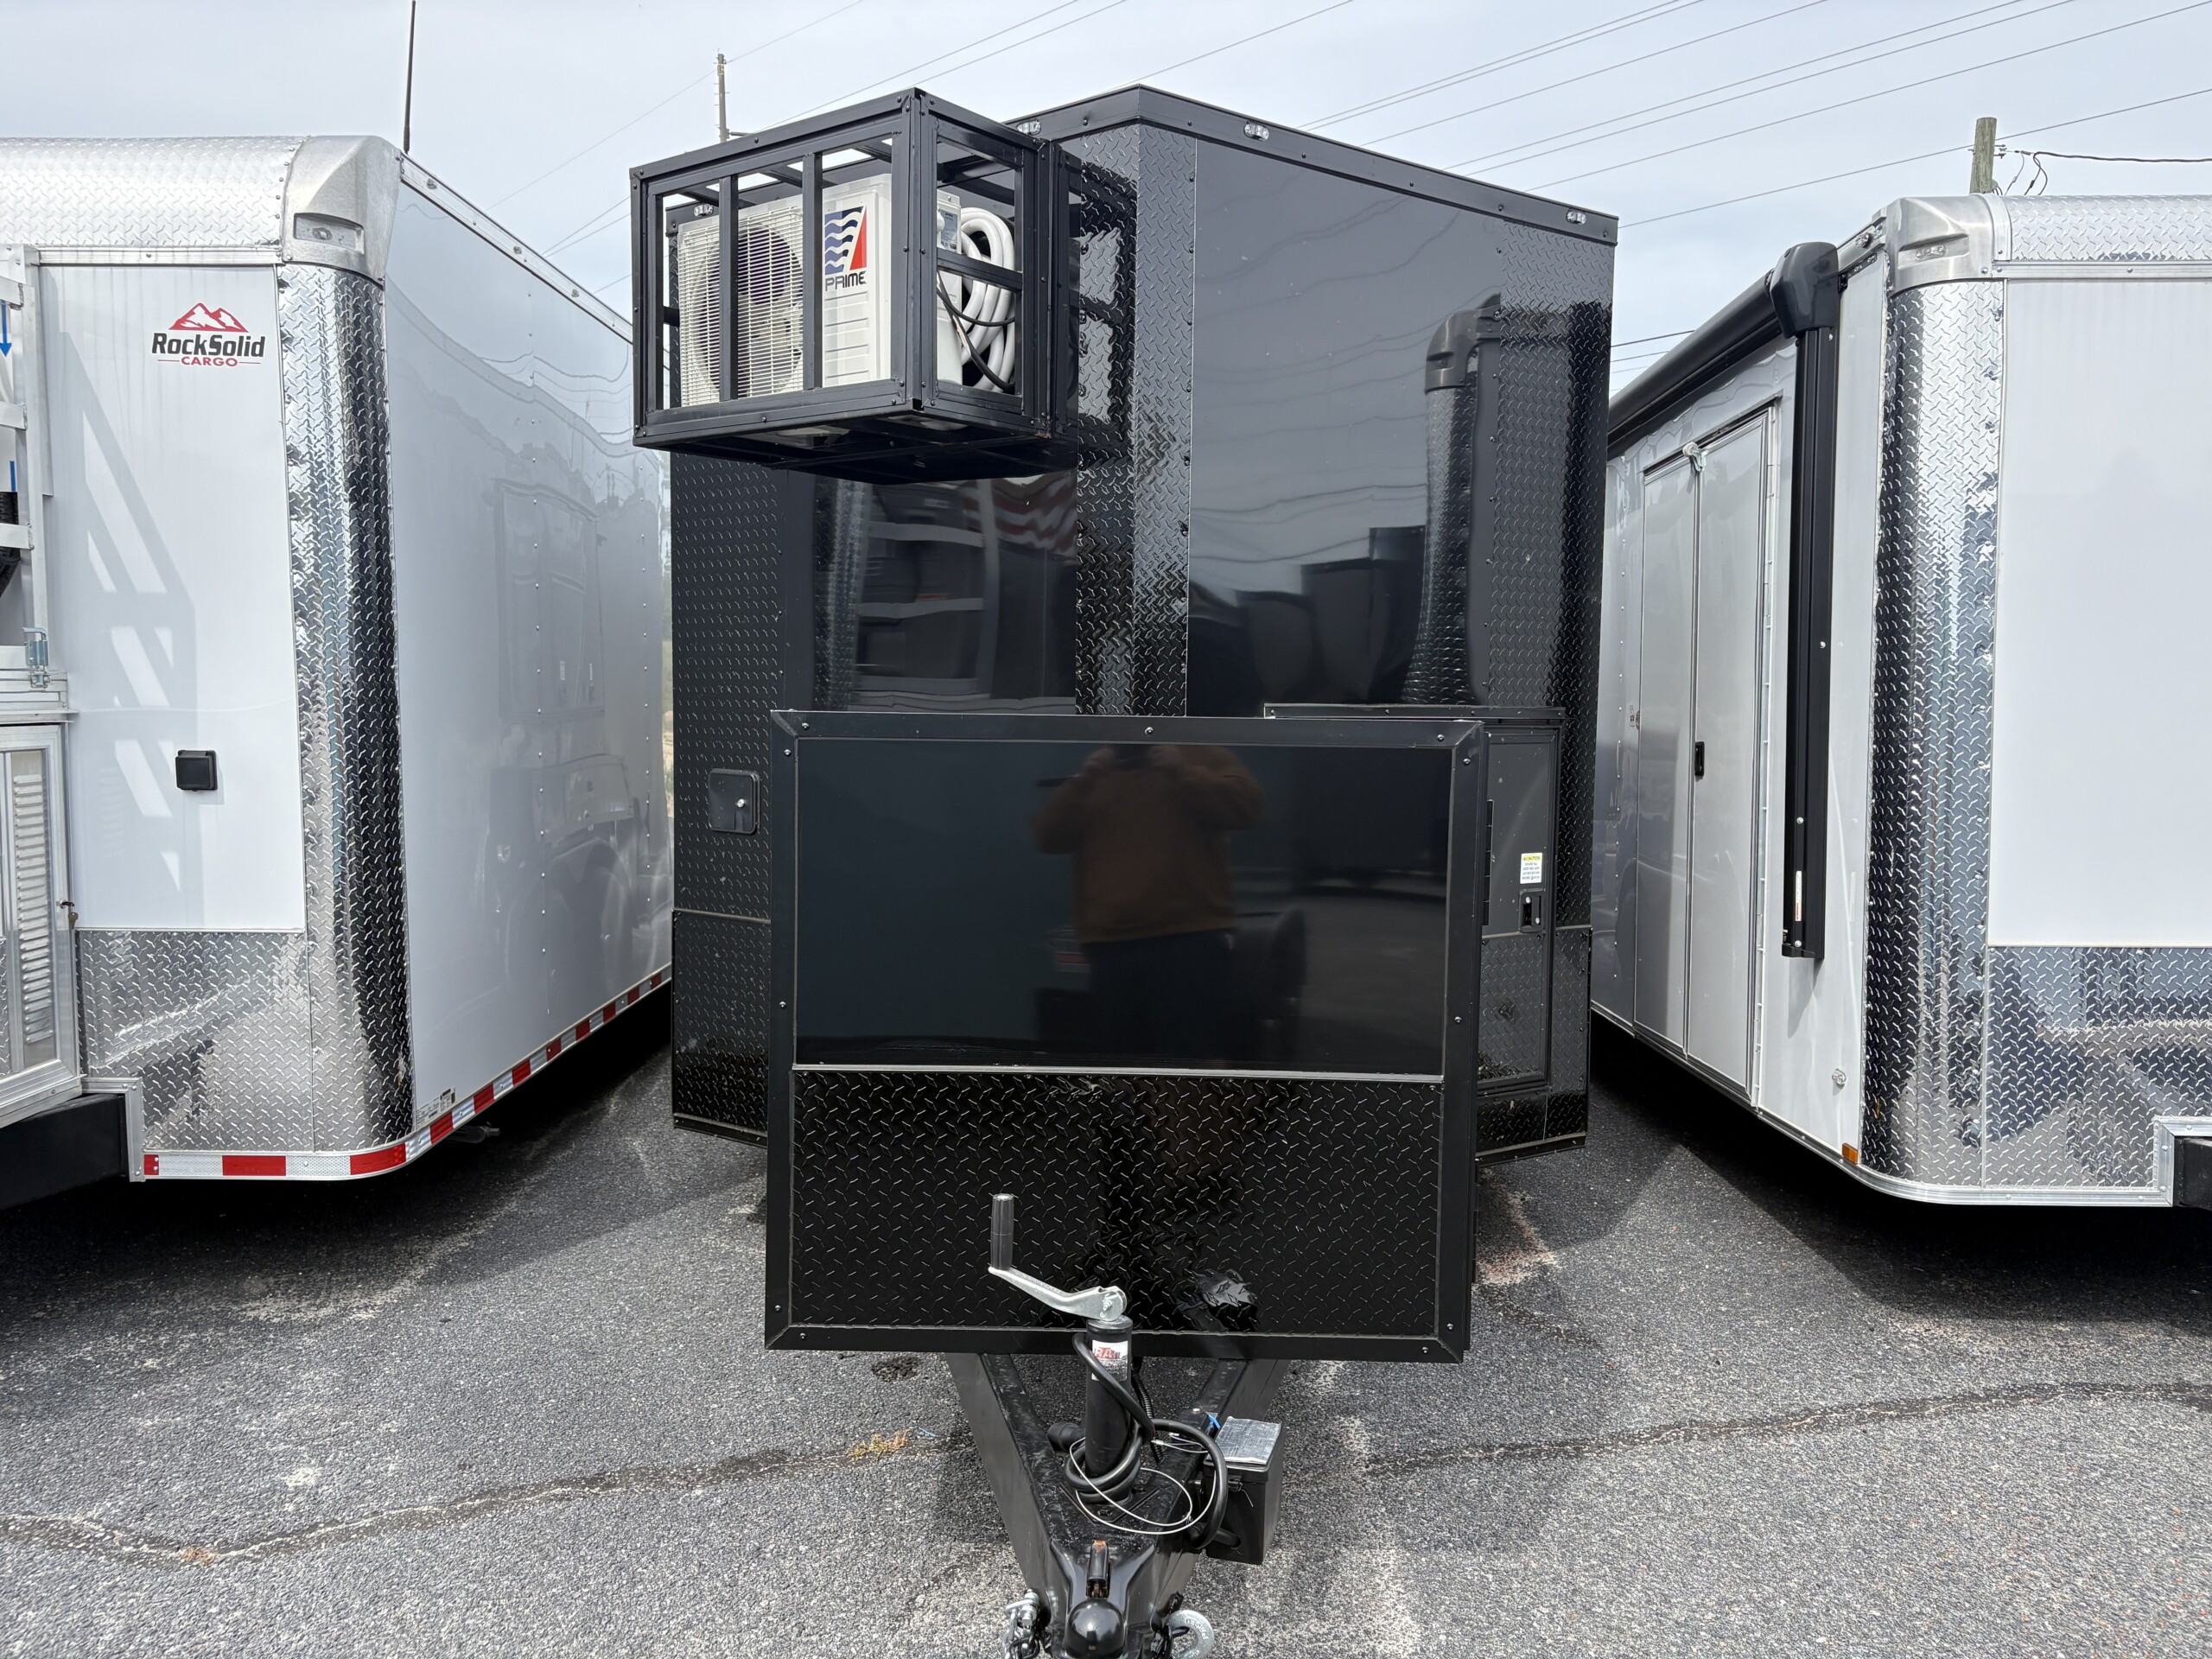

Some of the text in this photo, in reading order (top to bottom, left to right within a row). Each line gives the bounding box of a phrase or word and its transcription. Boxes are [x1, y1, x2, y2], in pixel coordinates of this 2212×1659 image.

[824, 270, 868, 292] PRIME
[151, 333, 266, 358] RockSolid
[181, 356, 238, 367] CARGO
